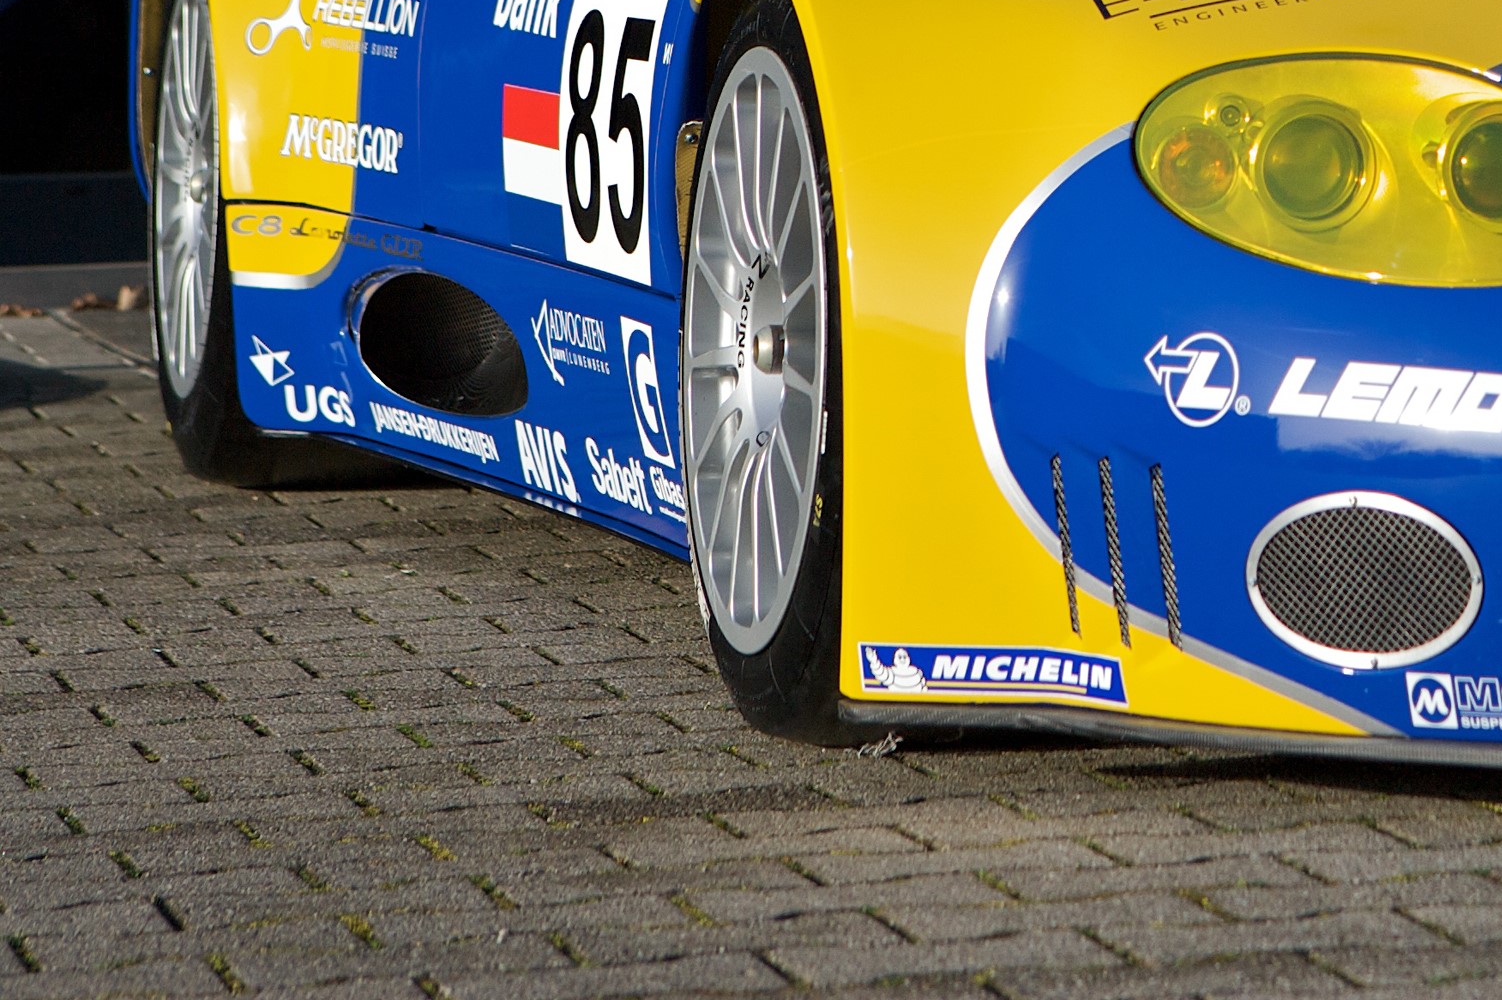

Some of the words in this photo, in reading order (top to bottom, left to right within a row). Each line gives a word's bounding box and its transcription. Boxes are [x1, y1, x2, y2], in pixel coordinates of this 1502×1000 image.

[371, 43, 399, 60] SUISSE
[565, 9, 656, 255] 85
[231, 215, 283, 236] C8
[549, 308, 607, 354] ADVOCATEN
[736, 276, 755, 369] RACING
[284, 384, 356, 428] UGS
[585, 436, 653, 516] Sabelt
[931, 654, 1113, 692] MICHELIN
